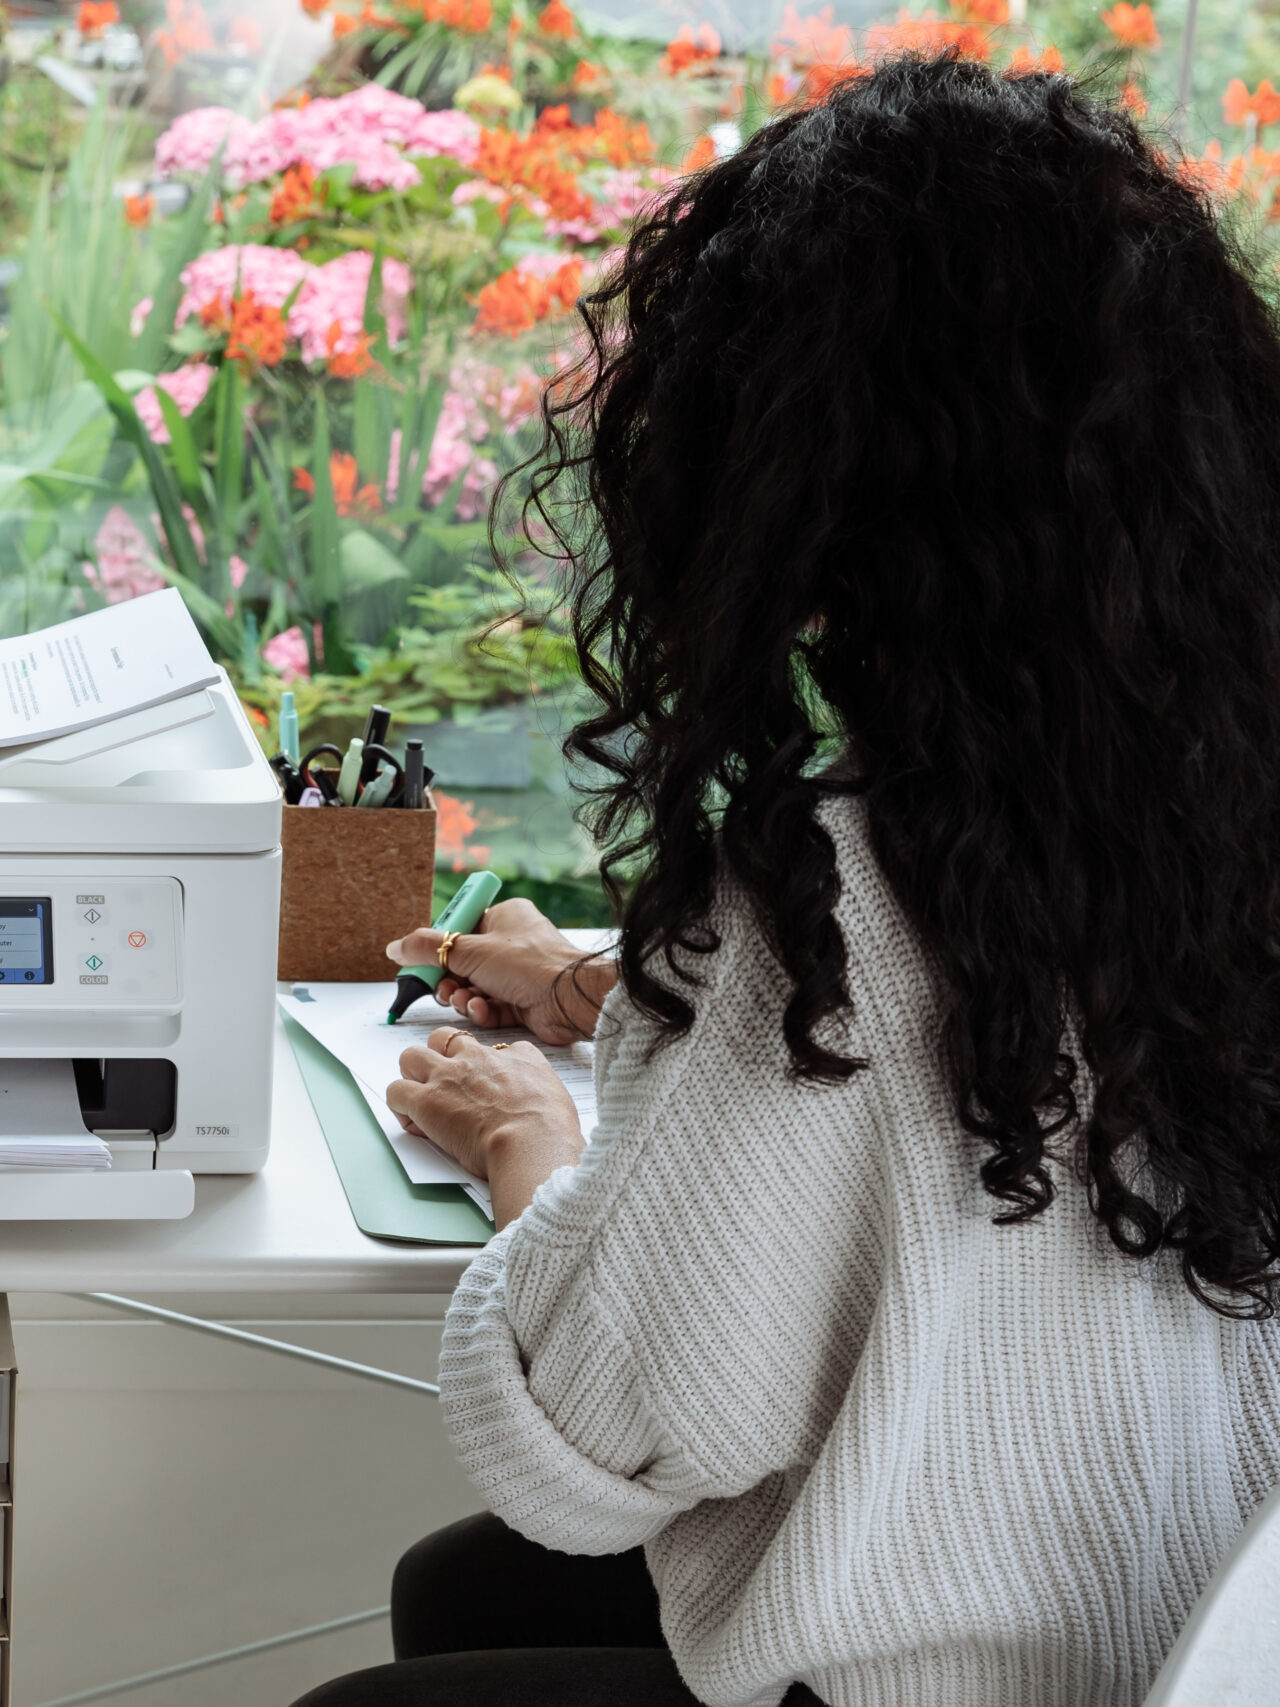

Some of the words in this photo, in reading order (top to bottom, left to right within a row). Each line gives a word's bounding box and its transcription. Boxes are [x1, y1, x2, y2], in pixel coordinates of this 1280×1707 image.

[78, 896, 104, 904] BLACK
[80, 976, 107, 984] COLOR
[195, 1126, 230, 1136] TS7750i
